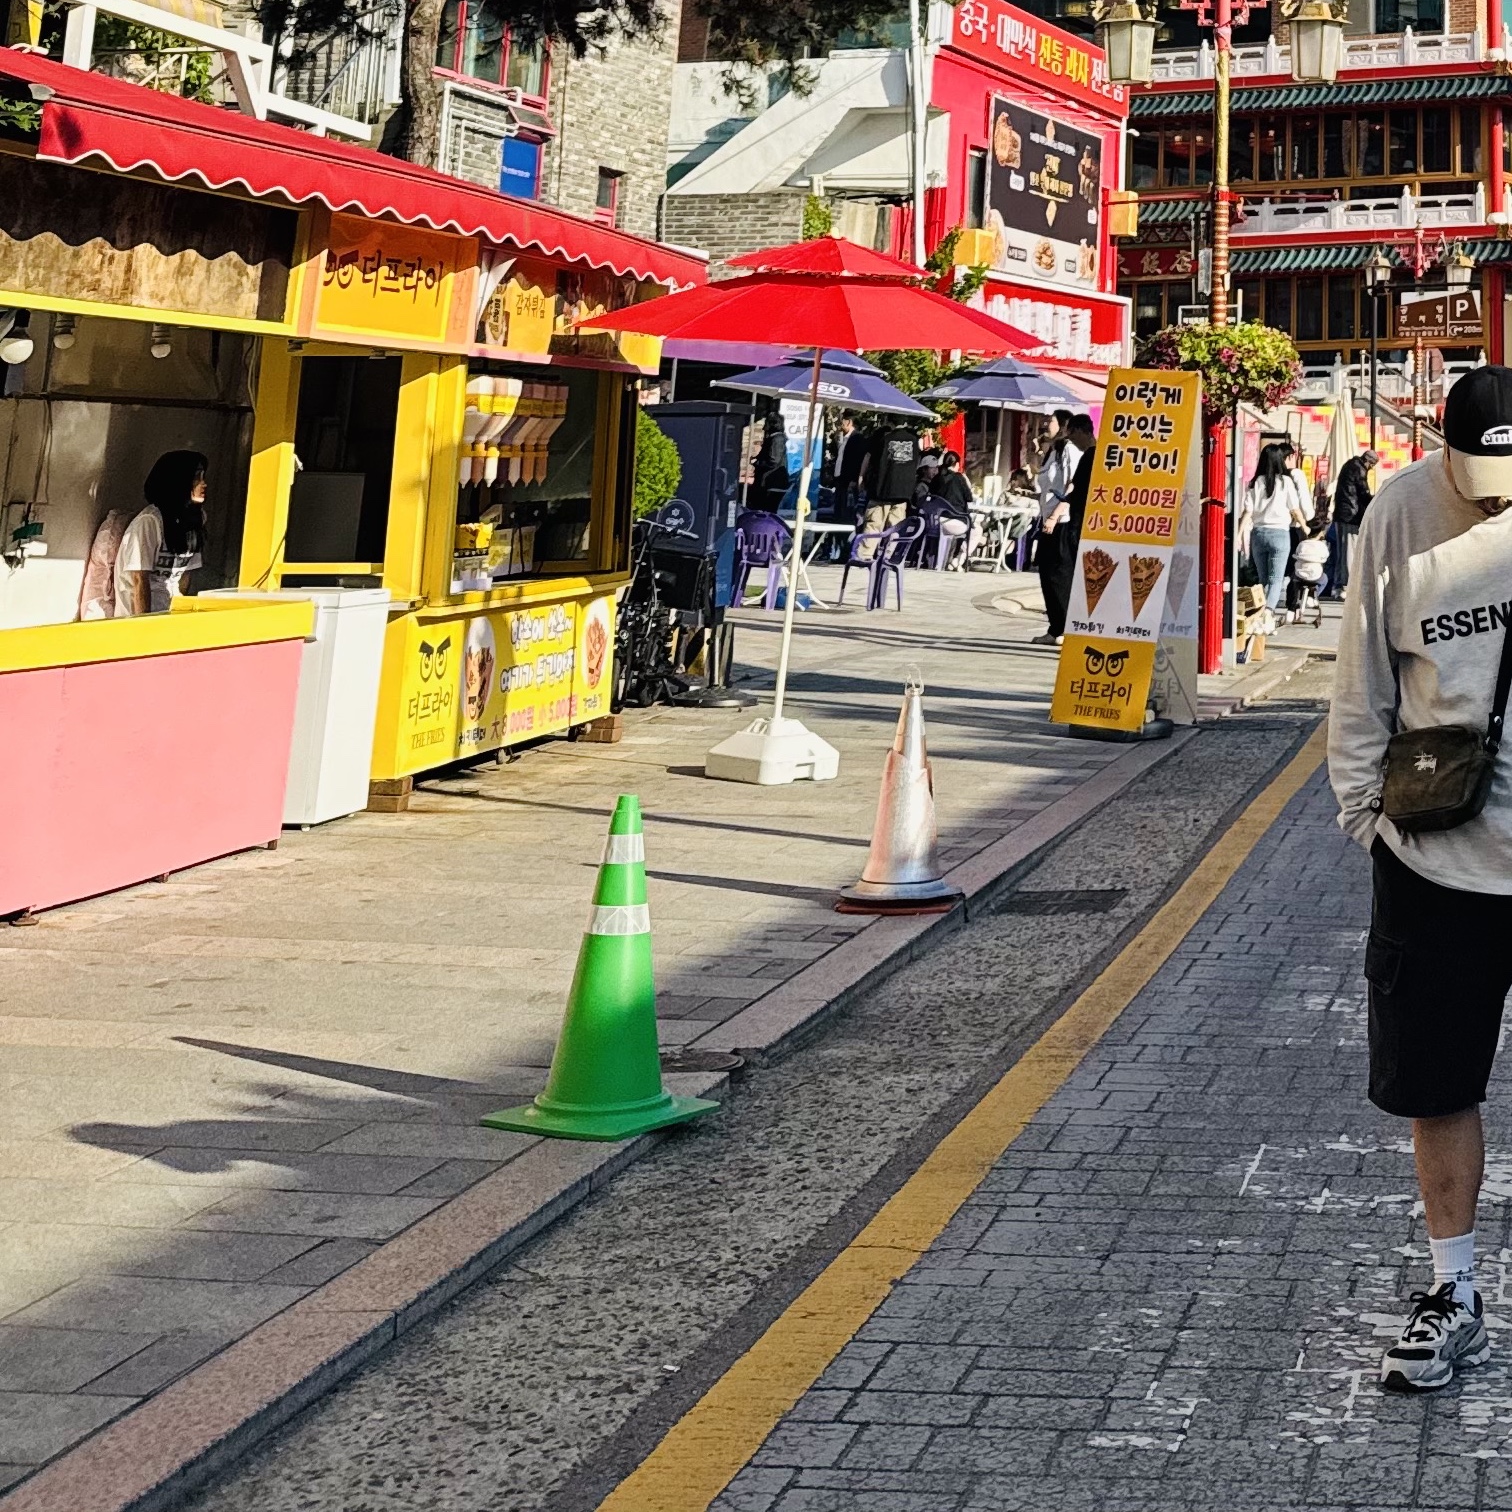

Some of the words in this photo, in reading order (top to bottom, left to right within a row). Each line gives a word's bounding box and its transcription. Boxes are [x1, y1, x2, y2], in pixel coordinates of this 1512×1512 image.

[362, 249, 444, 308] 더프라이
[1456, 299, 1469, 318] P
[1114, 381, 1183, 409] 이렇게
[1112, 414, 1173, 443] 맛있는
[1105, 444, 1179, 475] 튀김이!
[1091, 484, 1109, 505] 大
[1112, 486, 1178, 509] 8,000원
[1087, 511, 1104, 531] 小
[1108, 513, 1173, 537] 5,000원
[407, 684, 454, 726] 더프라이
[1070, 678, 1133, 706] 더프라이
[1073, 704, 1094, 717] THE
[1093, 706, 1121, 721] FRIES
